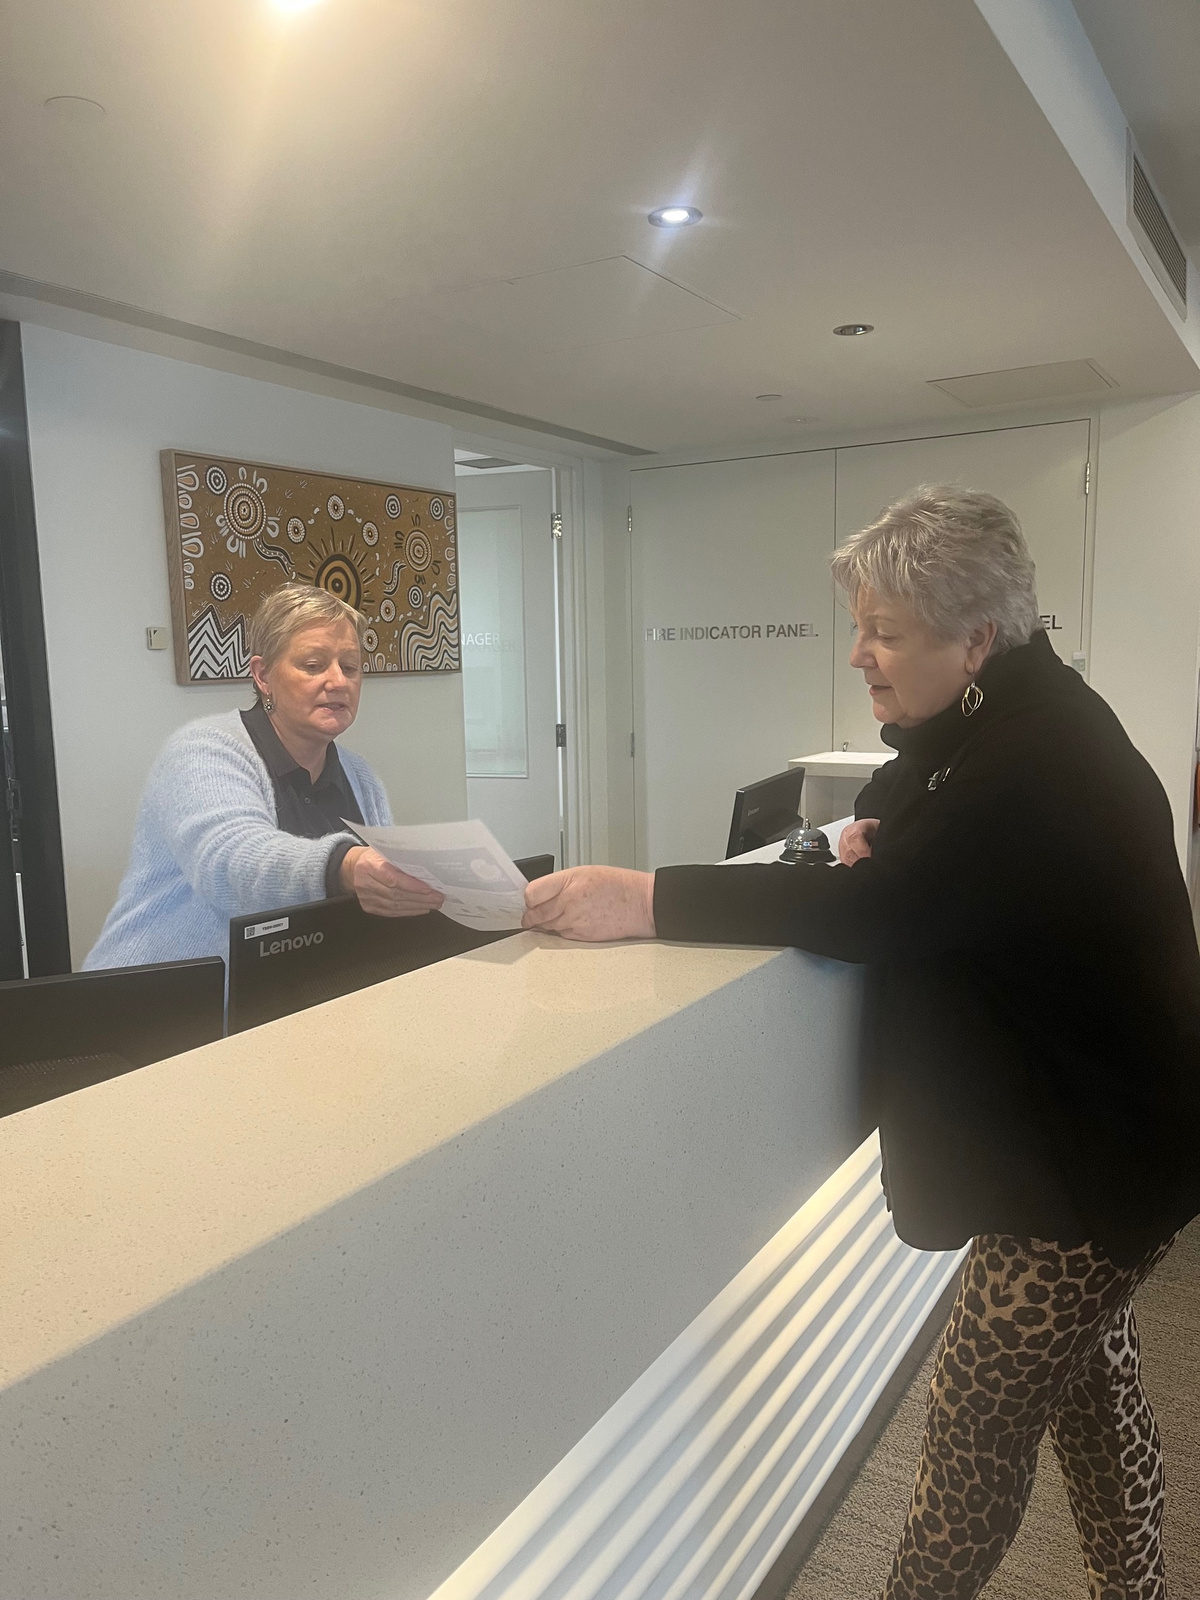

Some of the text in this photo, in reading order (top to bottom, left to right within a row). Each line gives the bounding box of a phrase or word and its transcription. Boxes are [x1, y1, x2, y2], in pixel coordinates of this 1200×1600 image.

[1039, 615, 1063, 630] EL
[461, 633, 500, 646] NAGER
[645, 628, 676, 641] FIRE
[680, 625, 761, 640] INDICATOR
[259, 931, 324, 957] Lenovo
